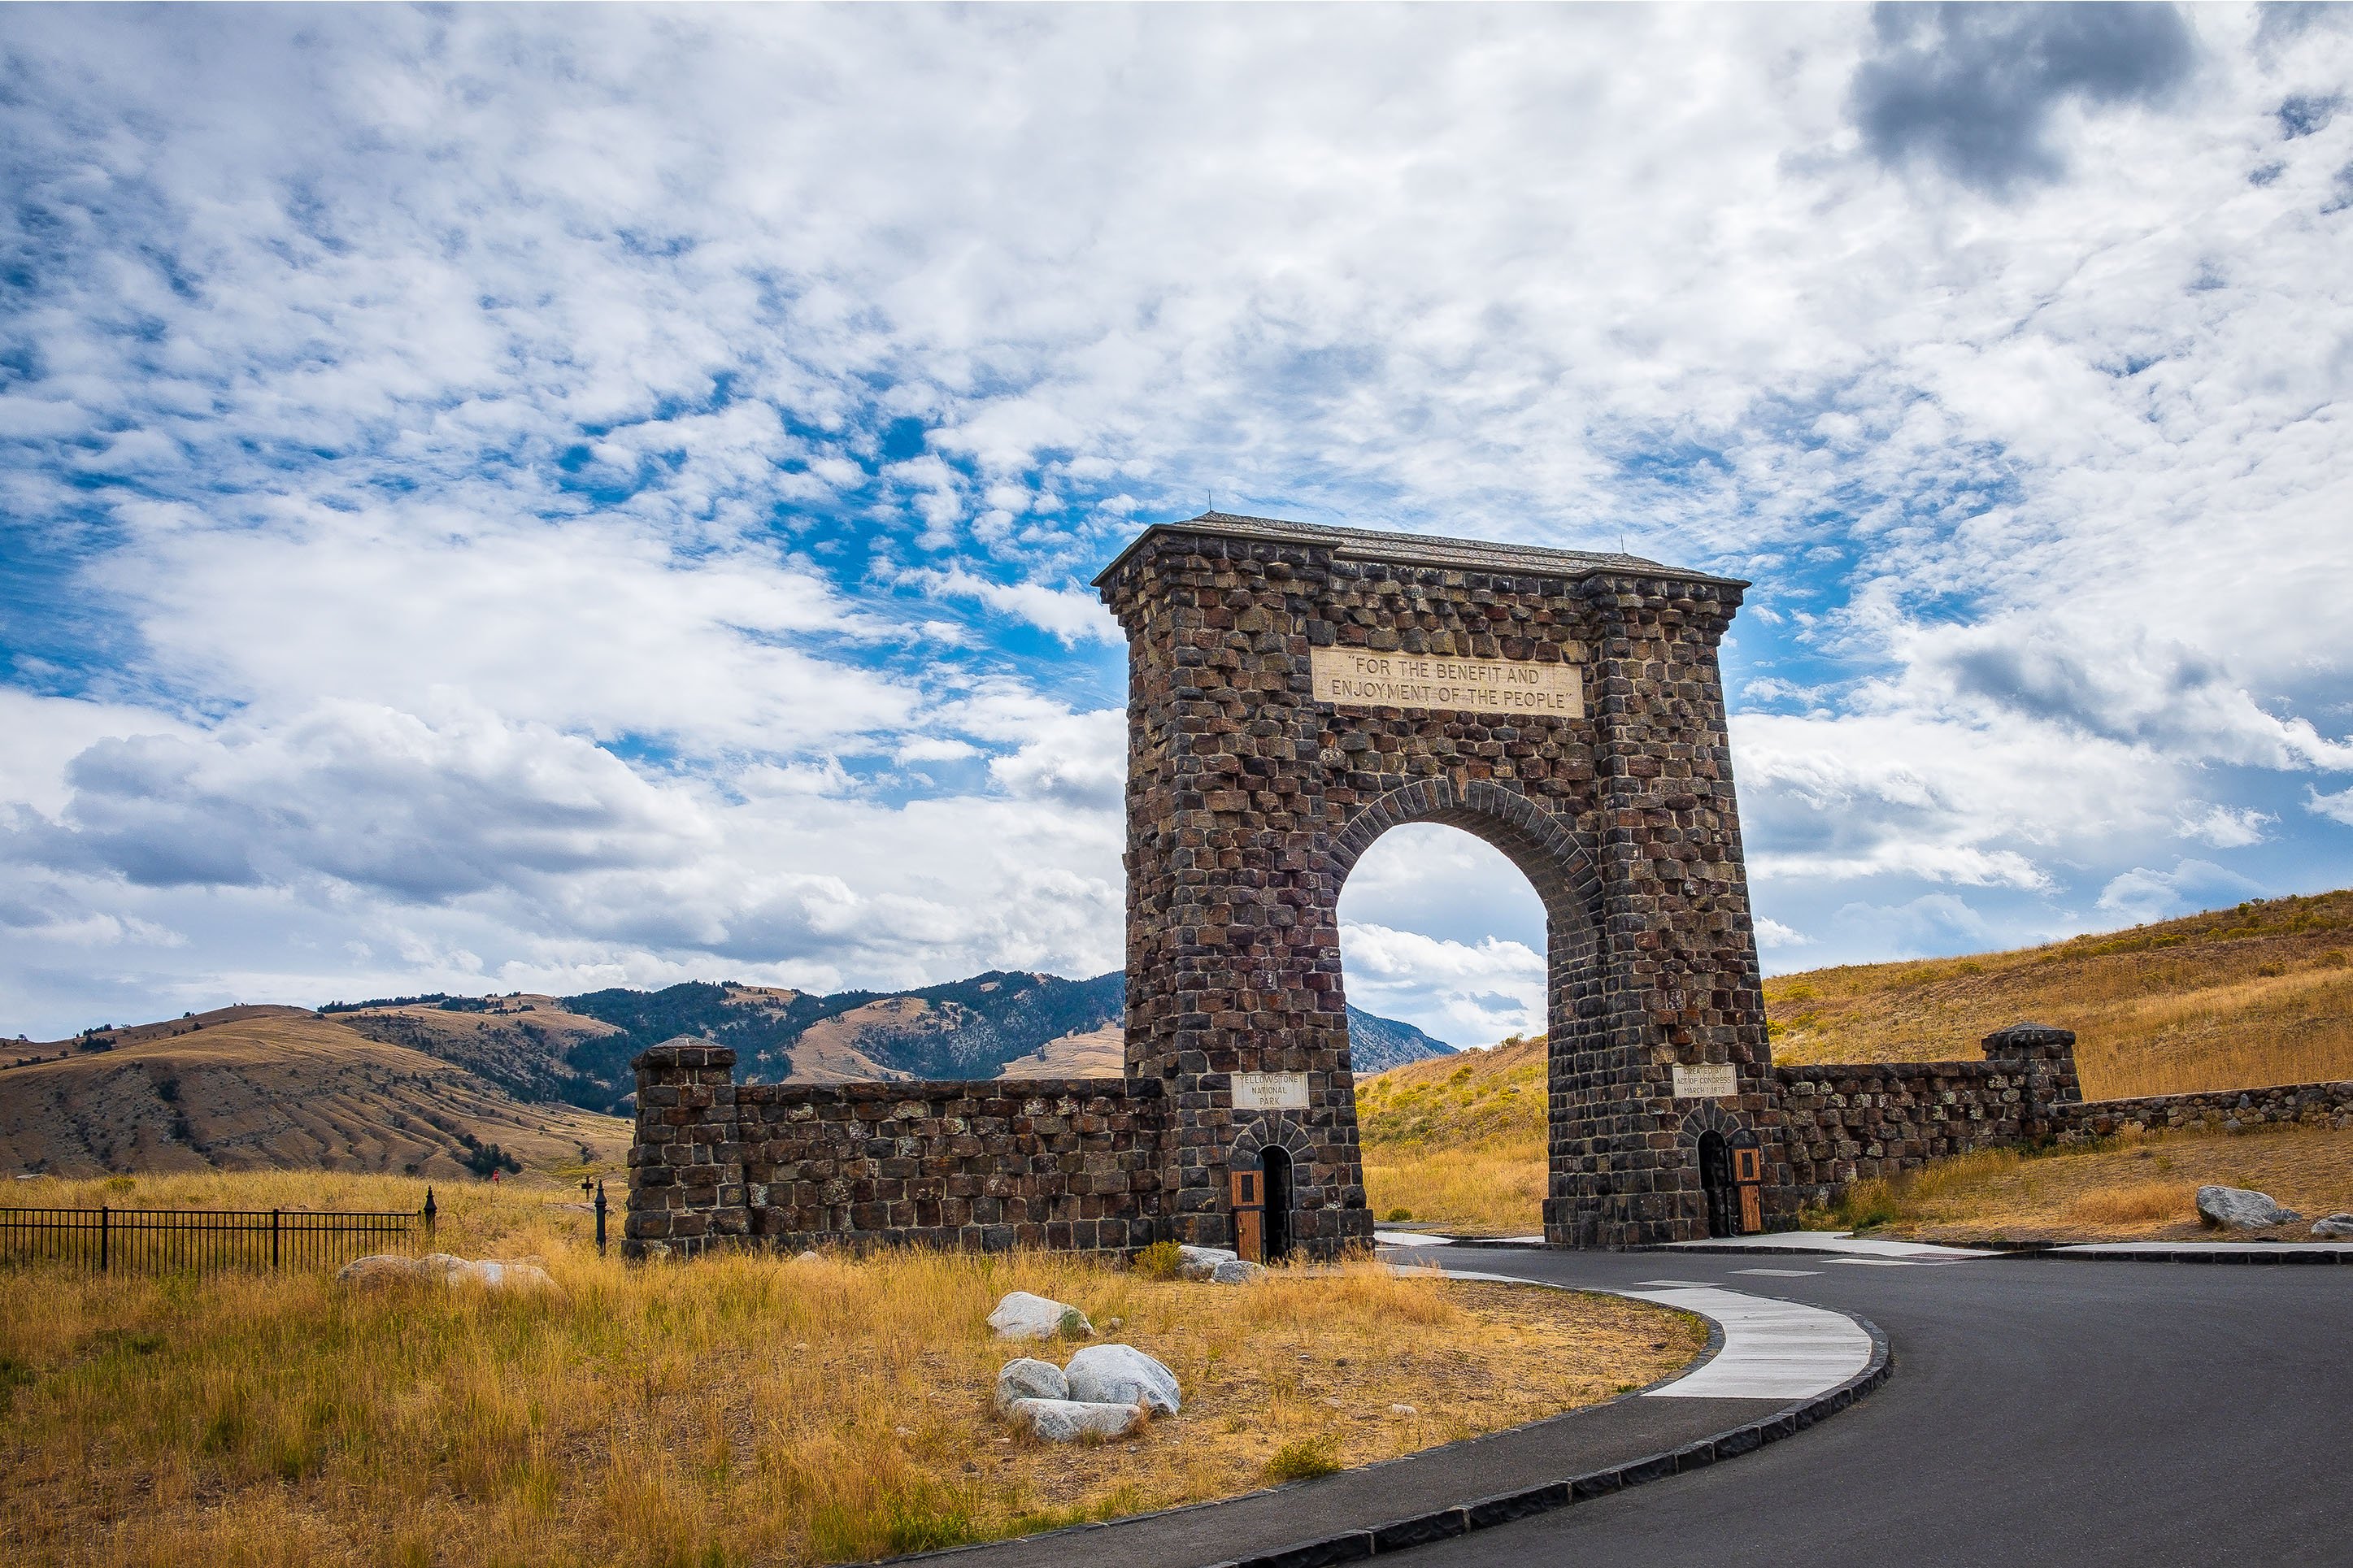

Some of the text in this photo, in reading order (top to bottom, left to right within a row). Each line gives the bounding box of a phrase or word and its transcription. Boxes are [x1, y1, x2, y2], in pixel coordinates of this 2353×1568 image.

[1398, 661, 1429, 678] THE
[1437, 664, 1501, 682] BENEFIT
[1507, 668, 1539, 684] AND
[1332, 680, 1431, 701] ENJOYMENT
[1438, 687, 1459, 702] OF
[1468, 688, 1498, 705] THE
[1240, 1075, 1298, 1084] YELLOWSTONE
[1259, 1097, 1280, 1105] PARK
